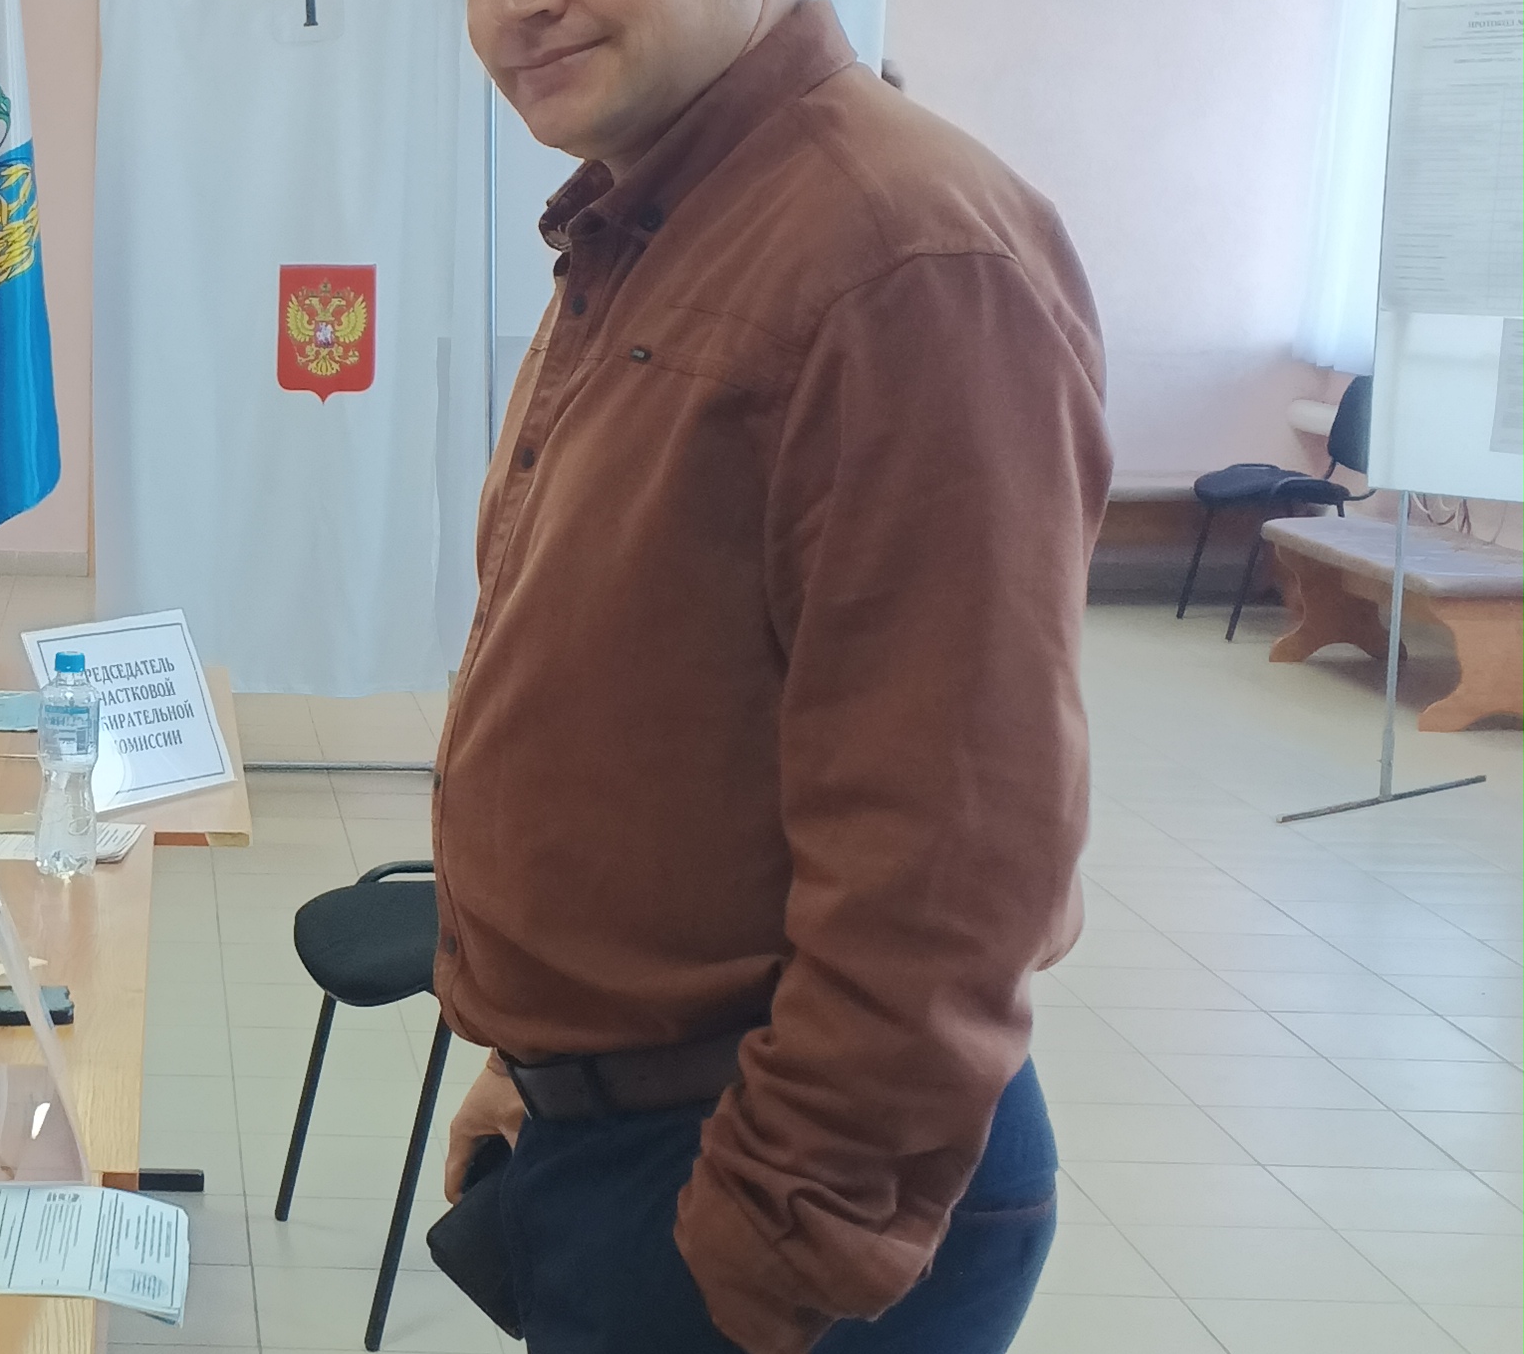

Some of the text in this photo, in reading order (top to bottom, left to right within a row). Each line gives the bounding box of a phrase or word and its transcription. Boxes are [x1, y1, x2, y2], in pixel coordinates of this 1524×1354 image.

[84, 657, 175, 685] РЕДСЕДАТЕЛЬ
[98, 677, 176, 707] ЧАСТКОВОЙ
[100, 699, 195, 731] БИРАТЕЛЬНОЙ
[114, 729, 183, 755] ОМИССИИ
